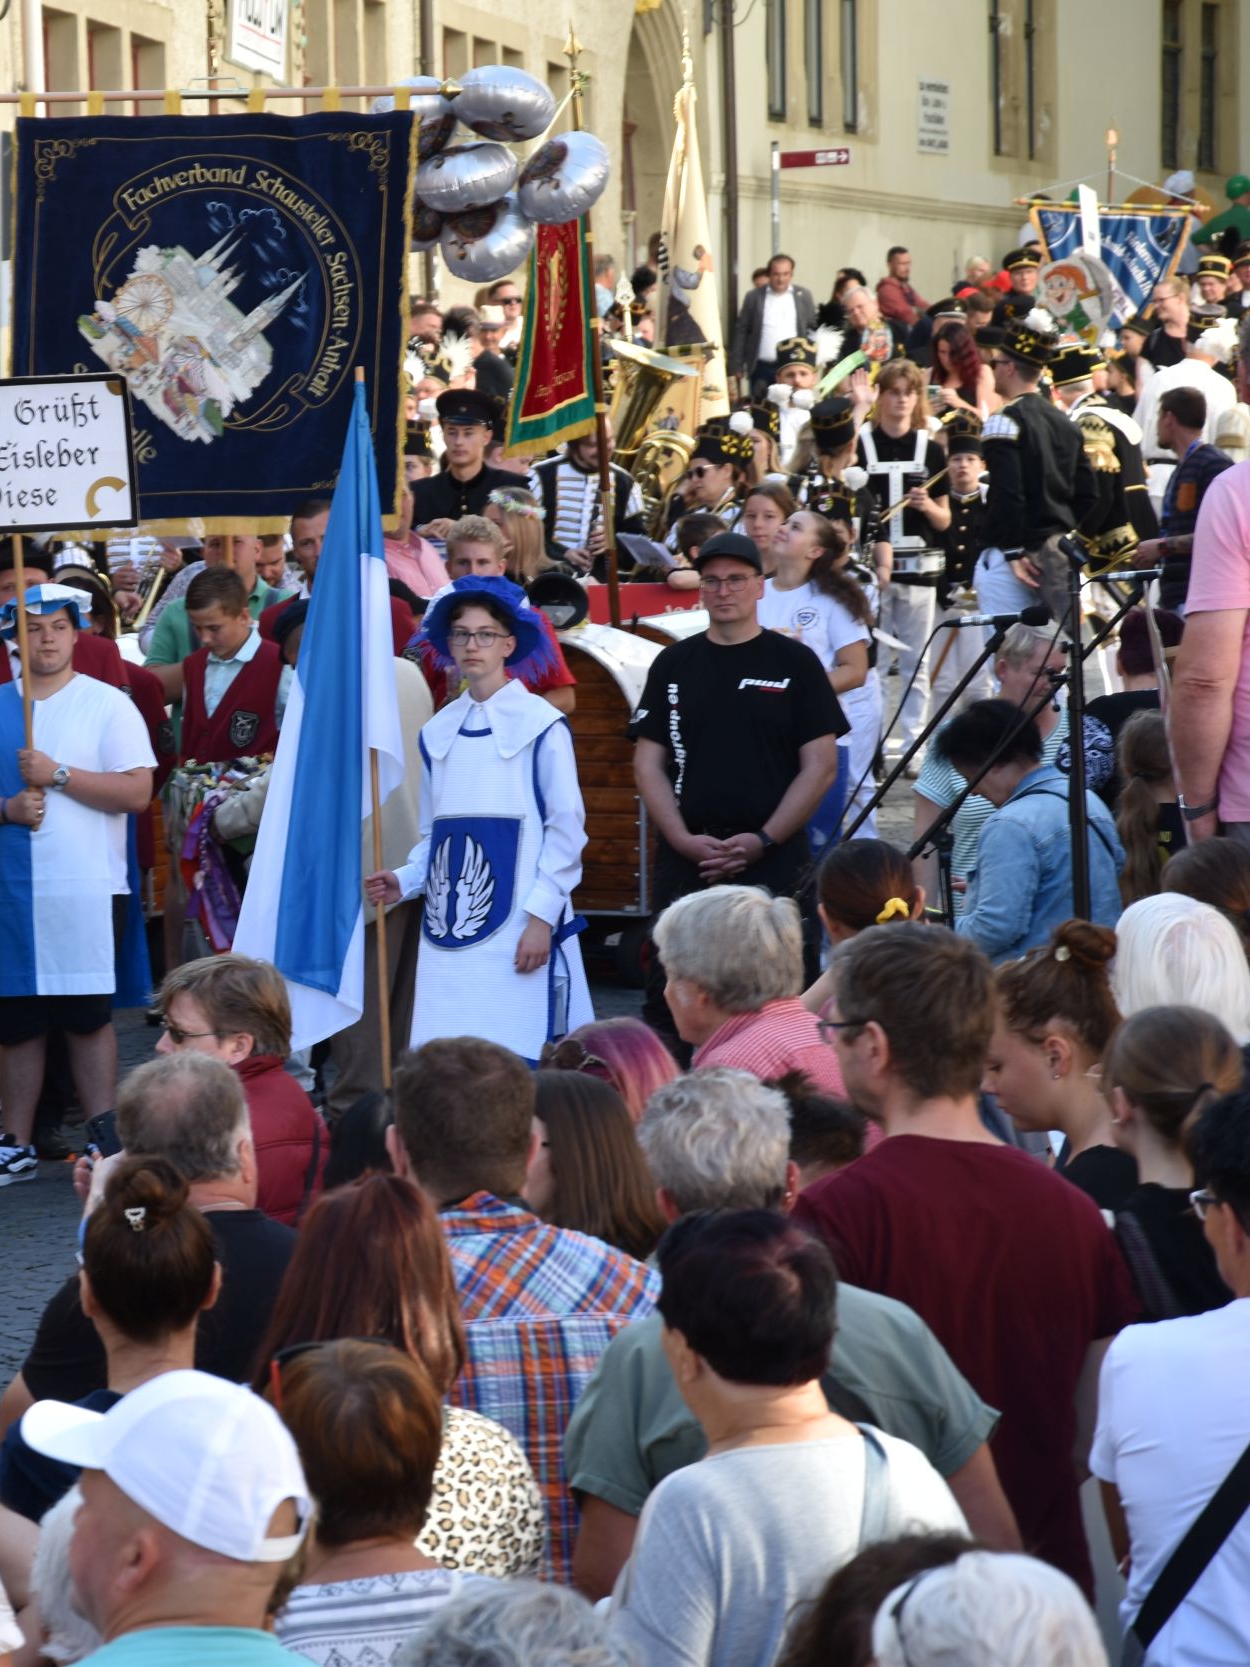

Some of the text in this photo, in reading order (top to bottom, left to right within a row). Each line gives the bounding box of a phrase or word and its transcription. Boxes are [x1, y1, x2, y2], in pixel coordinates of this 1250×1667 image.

[120, 162, 247, 211] Fachverband
[246, 169, 336, 247] Schausteller
[15, 392, 101, 428] Grüßt
[737, 678, 791, 690] pwd
